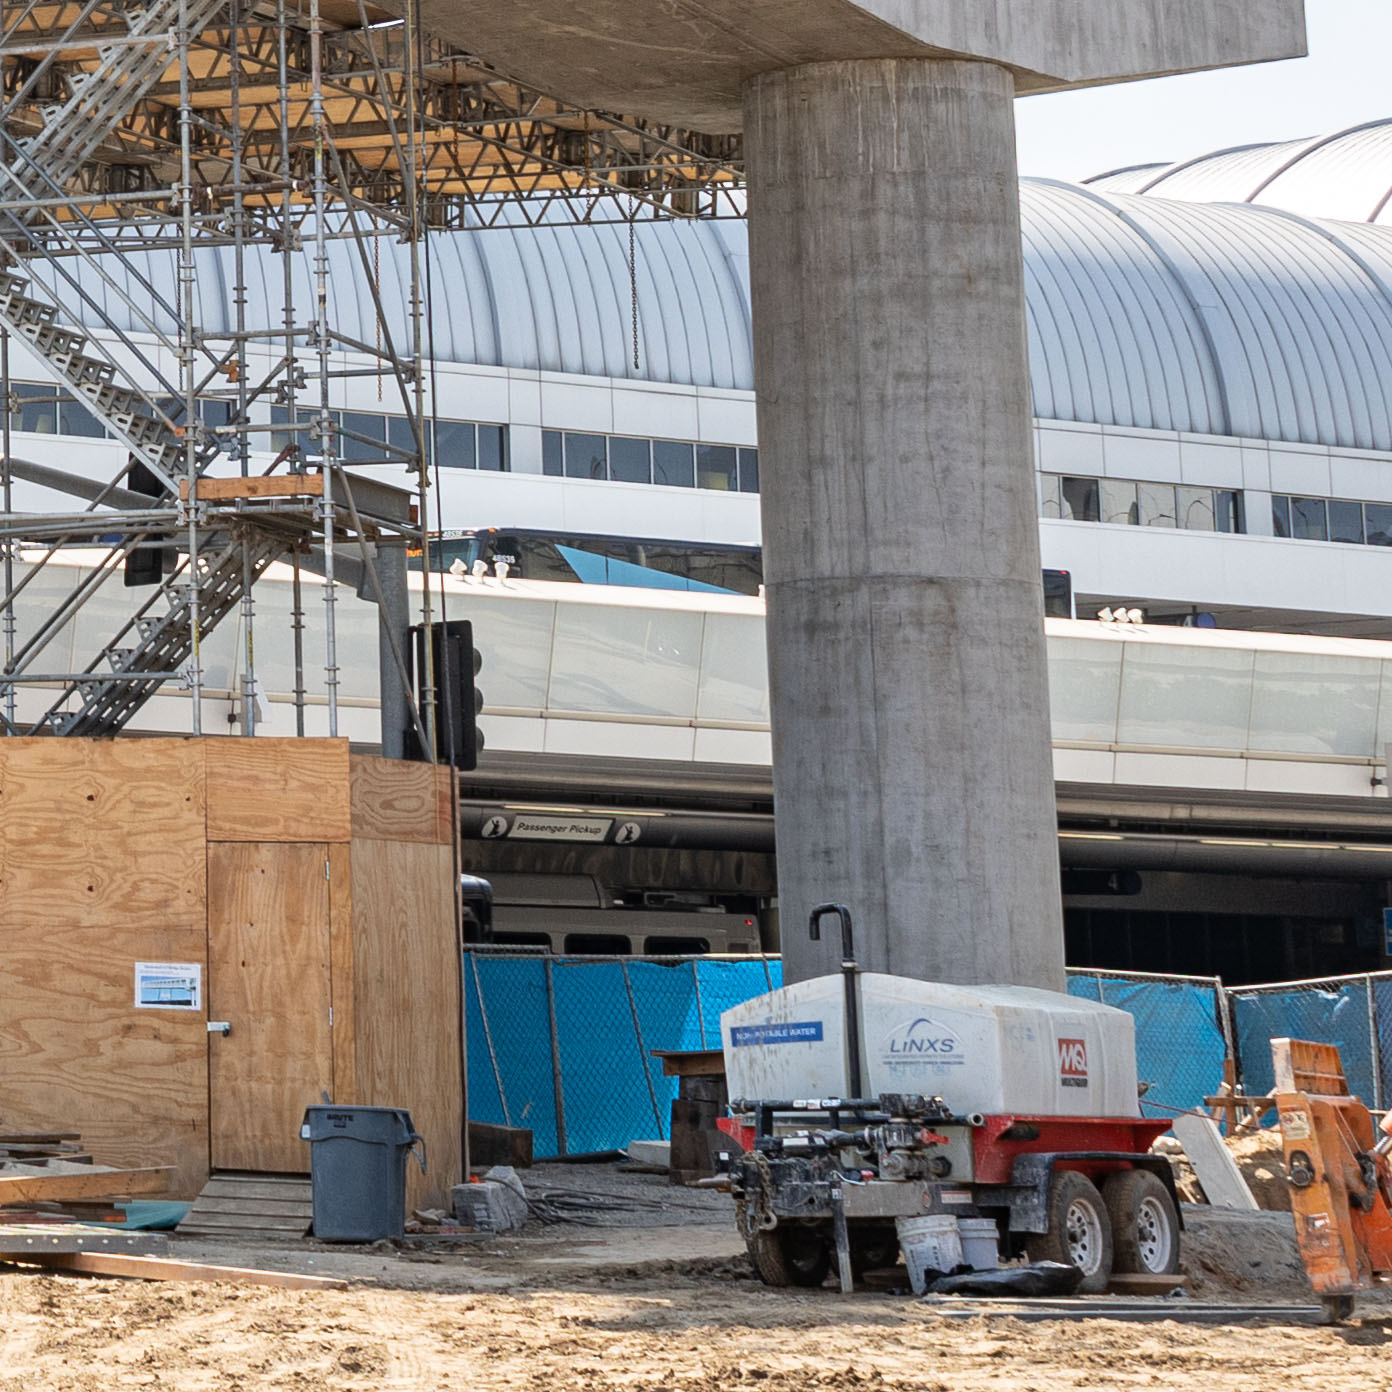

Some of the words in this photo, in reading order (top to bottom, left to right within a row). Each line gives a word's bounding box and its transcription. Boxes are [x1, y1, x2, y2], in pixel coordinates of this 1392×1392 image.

[516, 822, 568, 834] Passenger
[569, 825, 602, 836] Pickup
[789, 1027, 817, 1037] WATER
